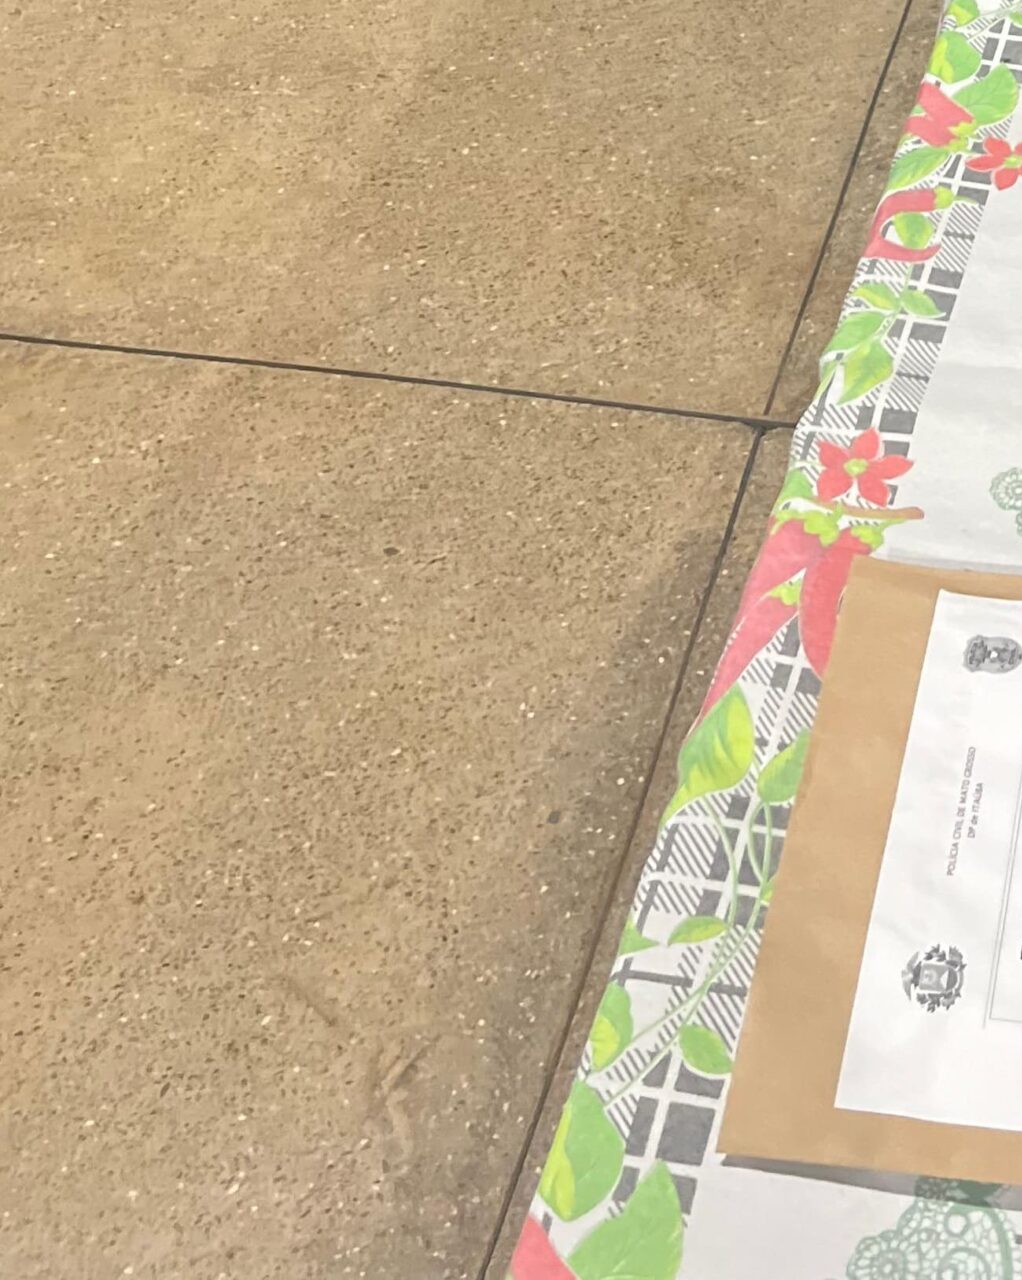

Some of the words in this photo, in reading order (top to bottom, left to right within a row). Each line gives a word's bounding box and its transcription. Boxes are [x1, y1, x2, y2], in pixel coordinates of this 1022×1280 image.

[963, 746, 976, 778] GROSSO
[959, 778, 970, 803] MATO
[956, 806, 965, 817] DE
[951, 818, 964, 840] CIVIL
[945, 841, 959, 876] POLÍCIA
